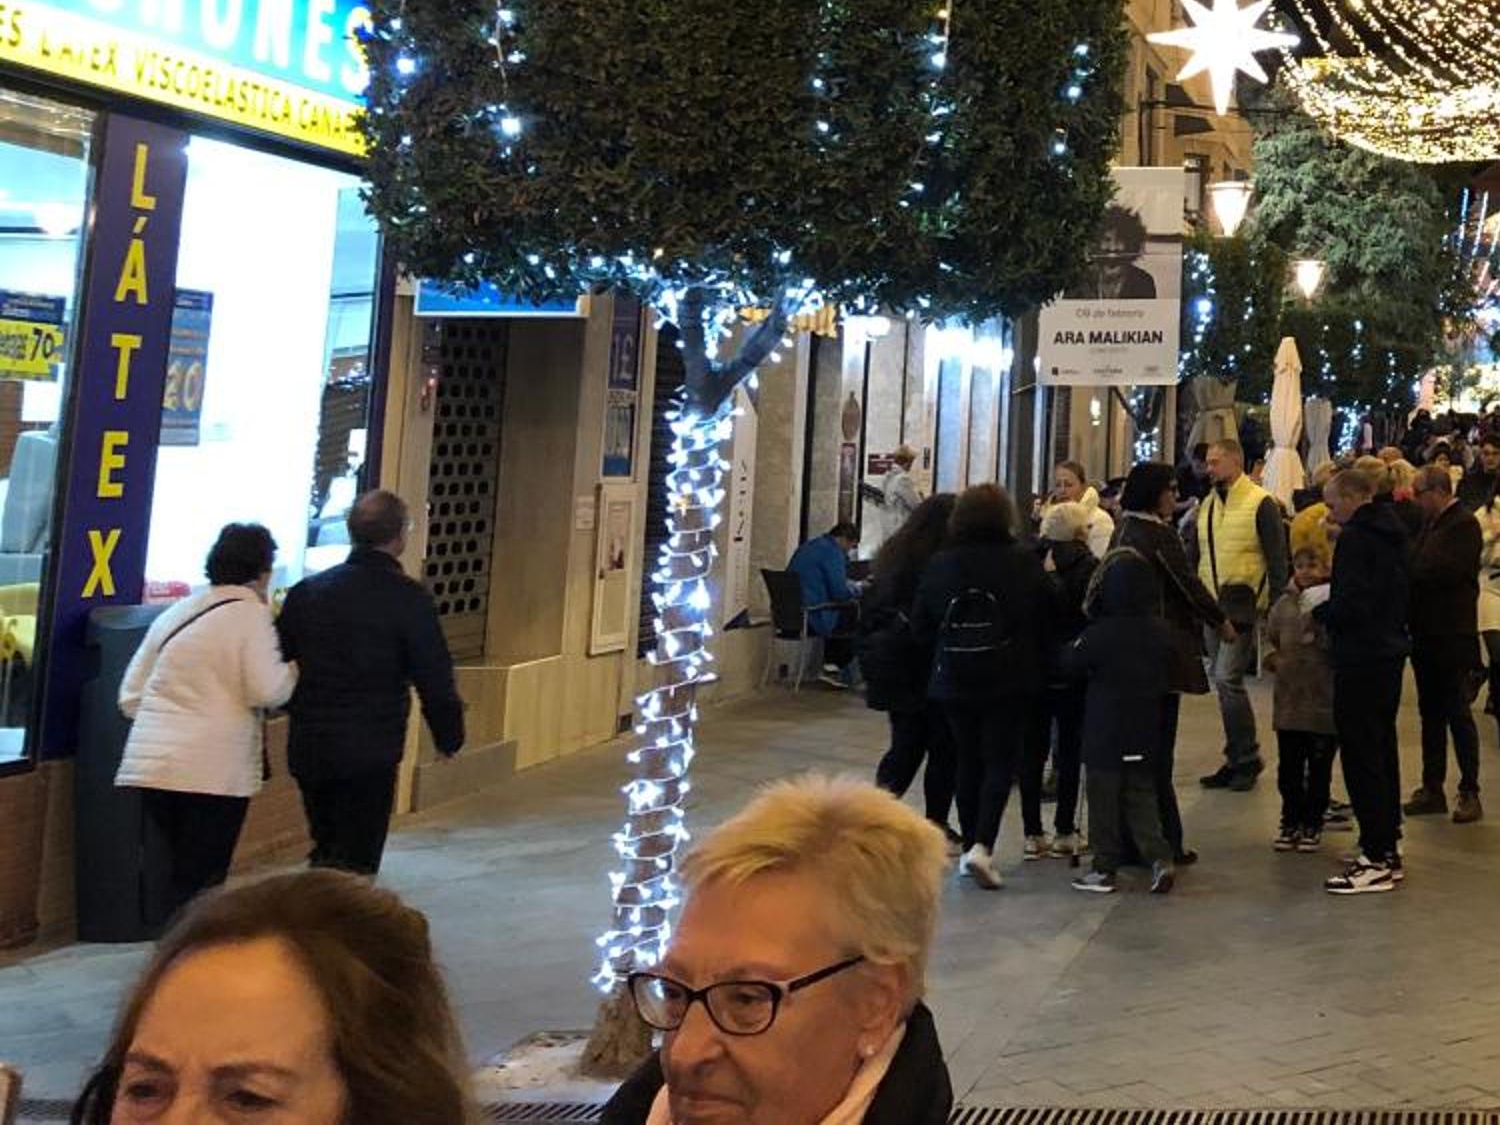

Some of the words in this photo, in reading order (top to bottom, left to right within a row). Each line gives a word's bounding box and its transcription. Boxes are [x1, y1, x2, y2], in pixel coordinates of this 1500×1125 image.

[81, 144, 156, 598] LÁTEX
[1053, 331, 1085, 345] ARA
[1088, 330, 1164, 345] MALIKIAN
